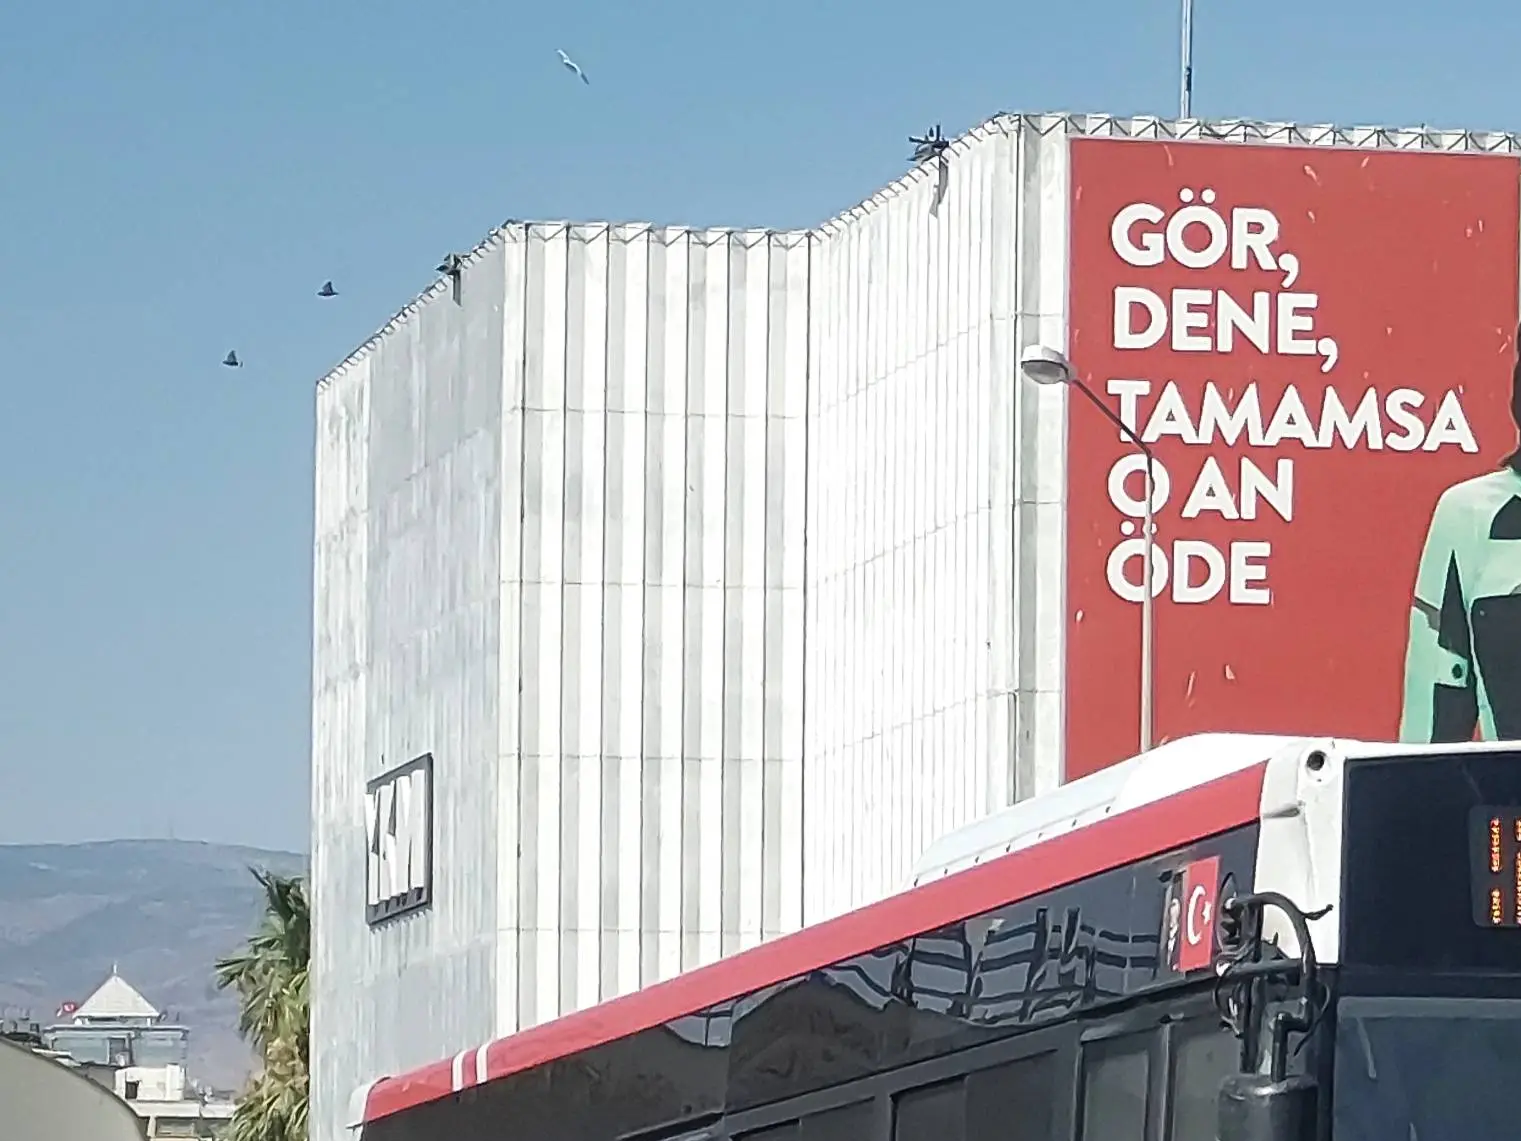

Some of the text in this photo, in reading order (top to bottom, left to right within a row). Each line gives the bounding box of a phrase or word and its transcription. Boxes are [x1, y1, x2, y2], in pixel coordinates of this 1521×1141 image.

[1111, 187, 1299, 288] GÖR,
[1112, 286, 1339, 373] DENE,
[1107, 379, 1479, 453] TAMAMSA
[1107, 452, 1294, 523] O AN
[1106, 520, 1272, 605] ÖDE
